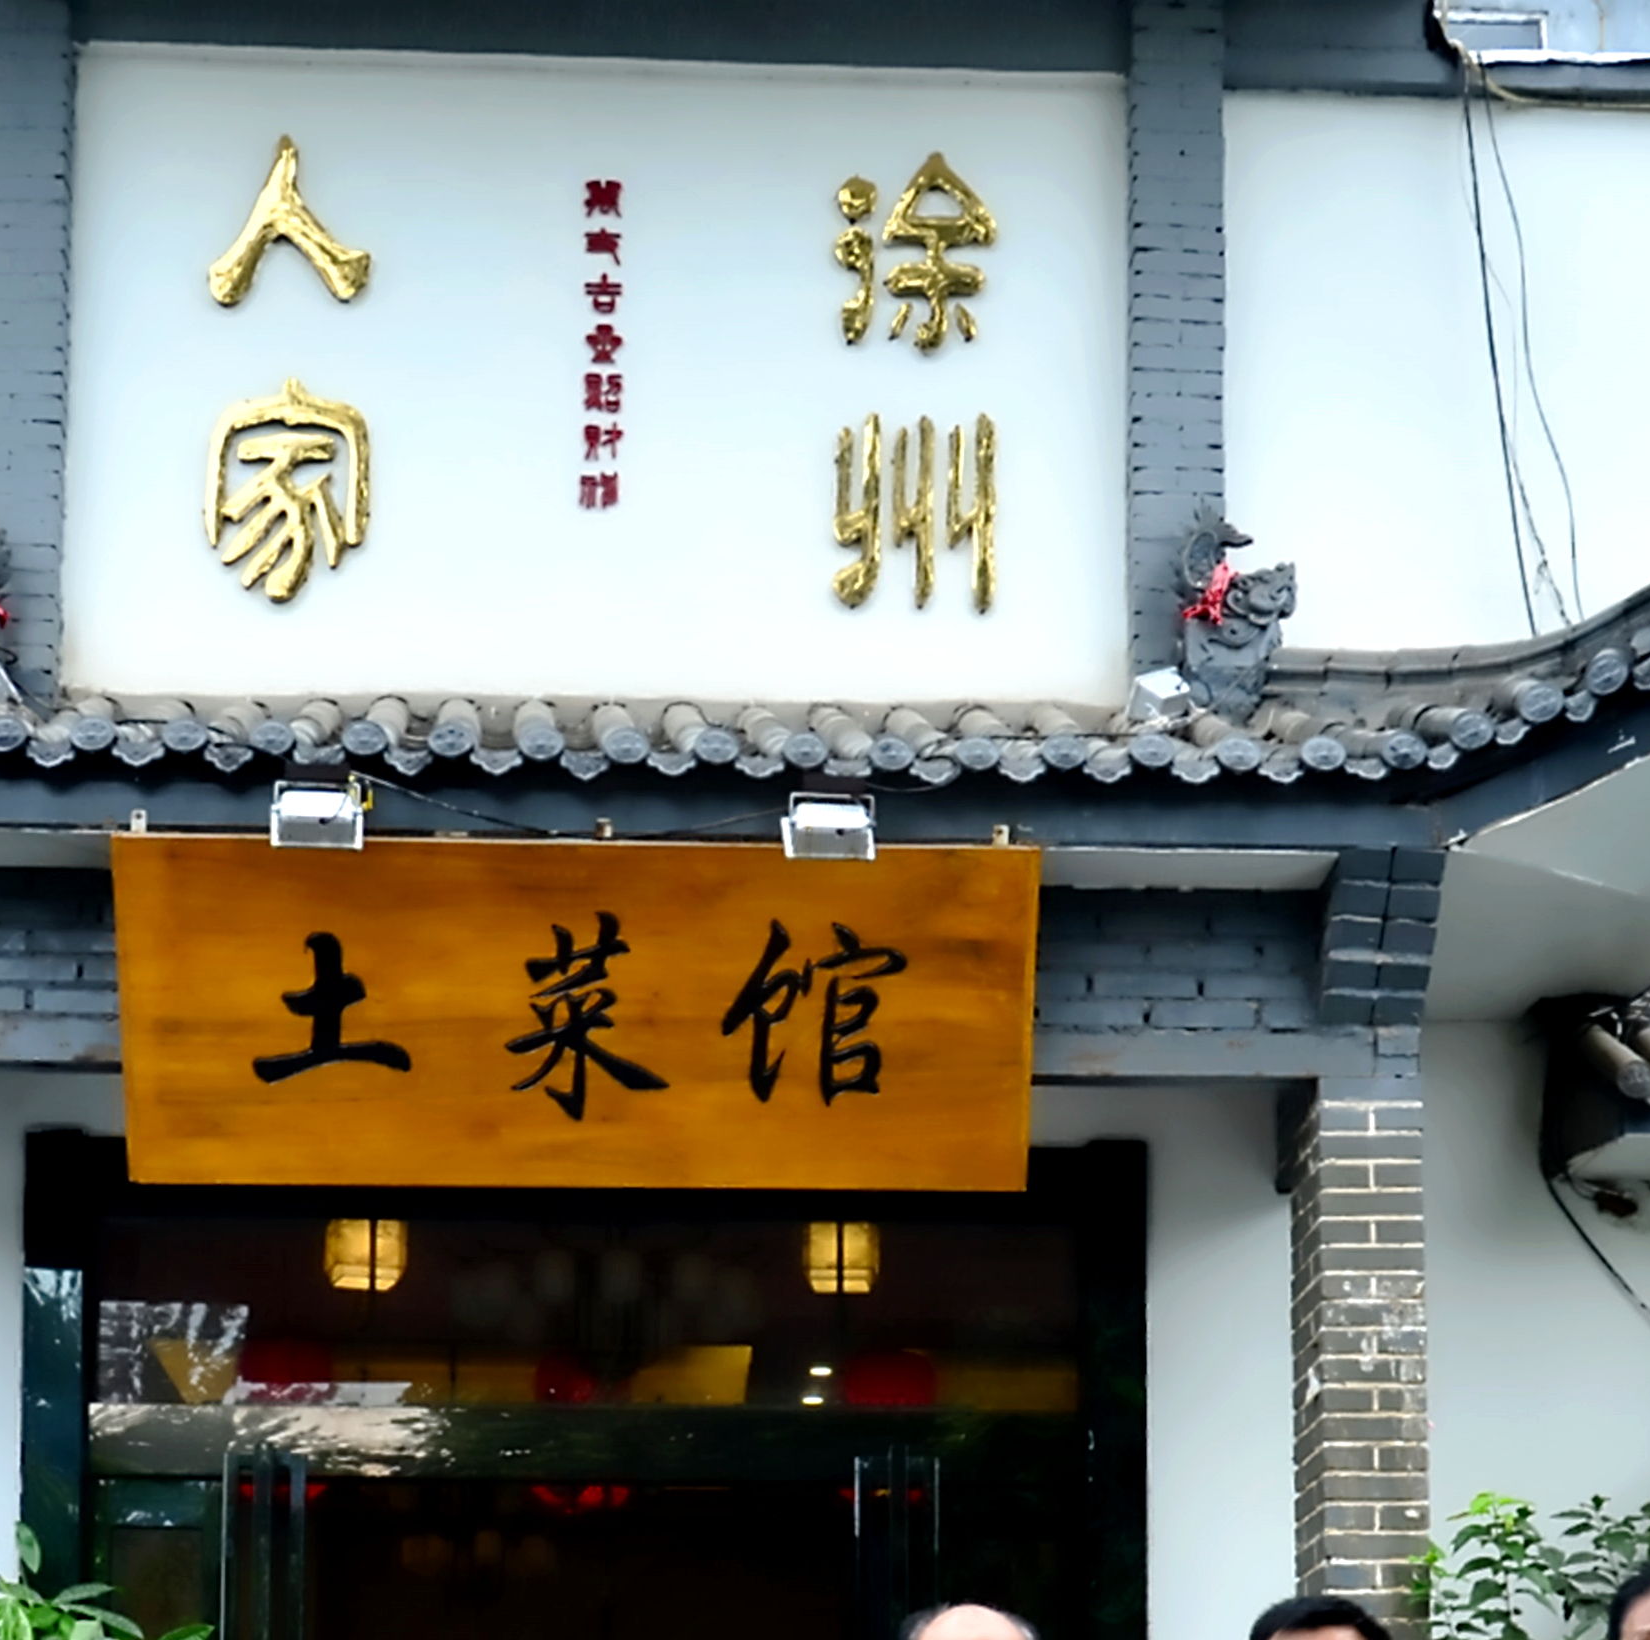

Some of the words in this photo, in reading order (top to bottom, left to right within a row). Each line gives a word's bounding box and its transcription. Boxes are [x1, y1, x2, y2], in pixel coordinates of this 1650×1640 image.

[203, 133, 371, 606] 人家
[252, 911, 907, 1121] 土菜馆
